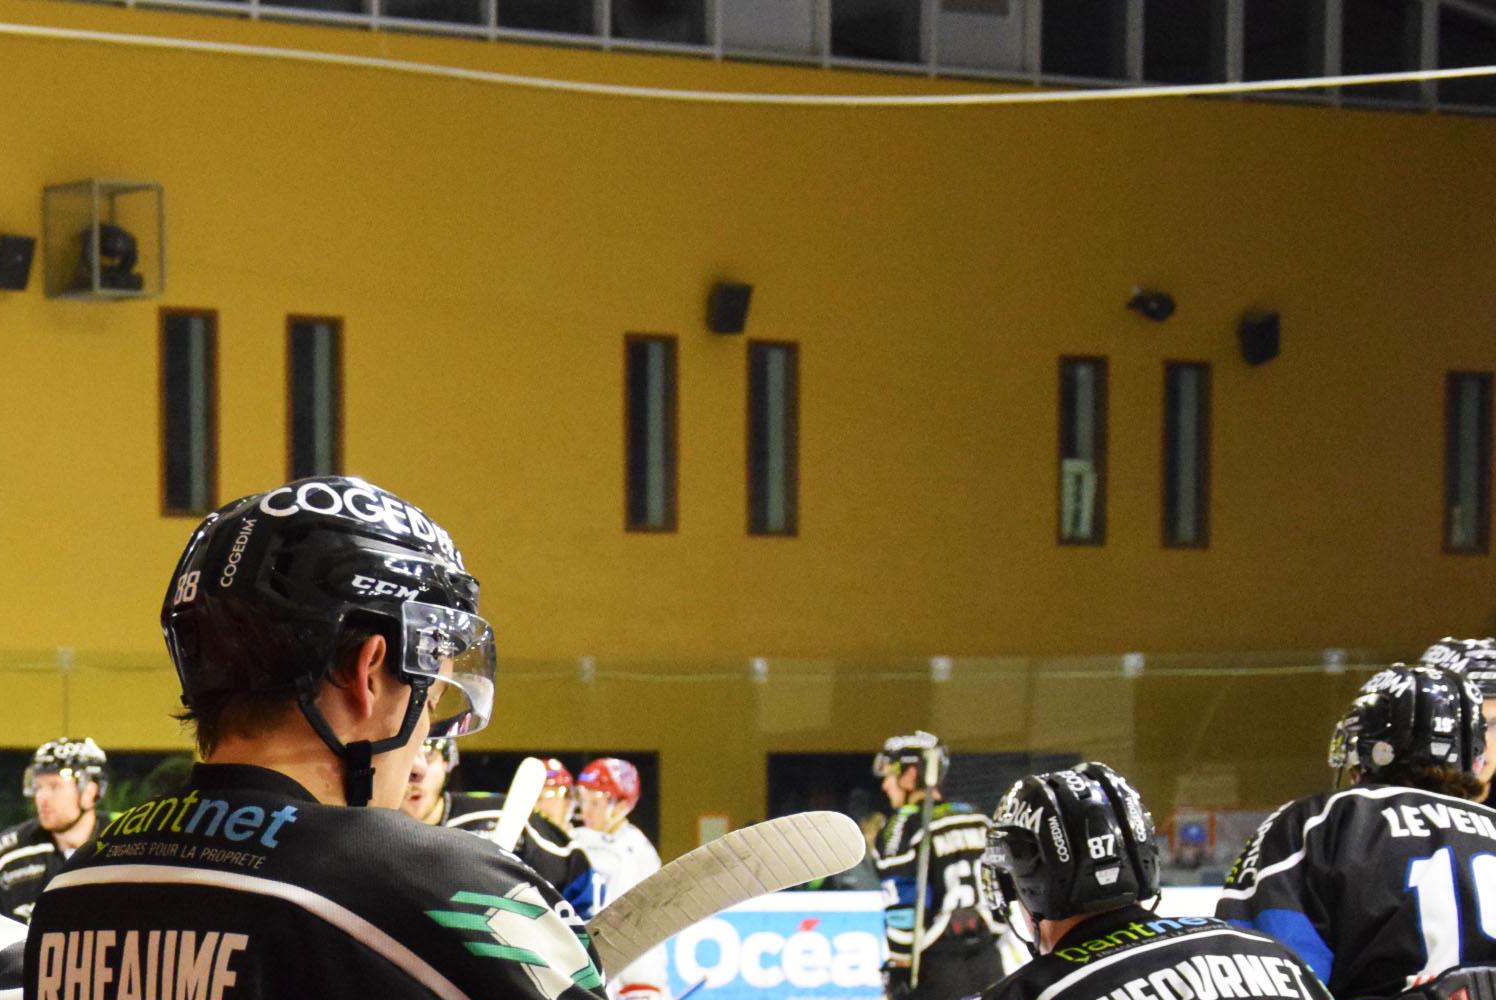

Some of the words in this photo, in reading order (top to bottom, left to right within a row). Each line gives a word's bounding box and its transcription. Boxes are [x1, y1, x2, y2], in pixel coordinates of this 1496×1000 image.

[221, 518, 257, 587] COGEDIM
[351, 574, 419, 601] CCM
[1047, 816, 1070, 862] COGEDIM
[1087, 834, 1116, 859] 87
